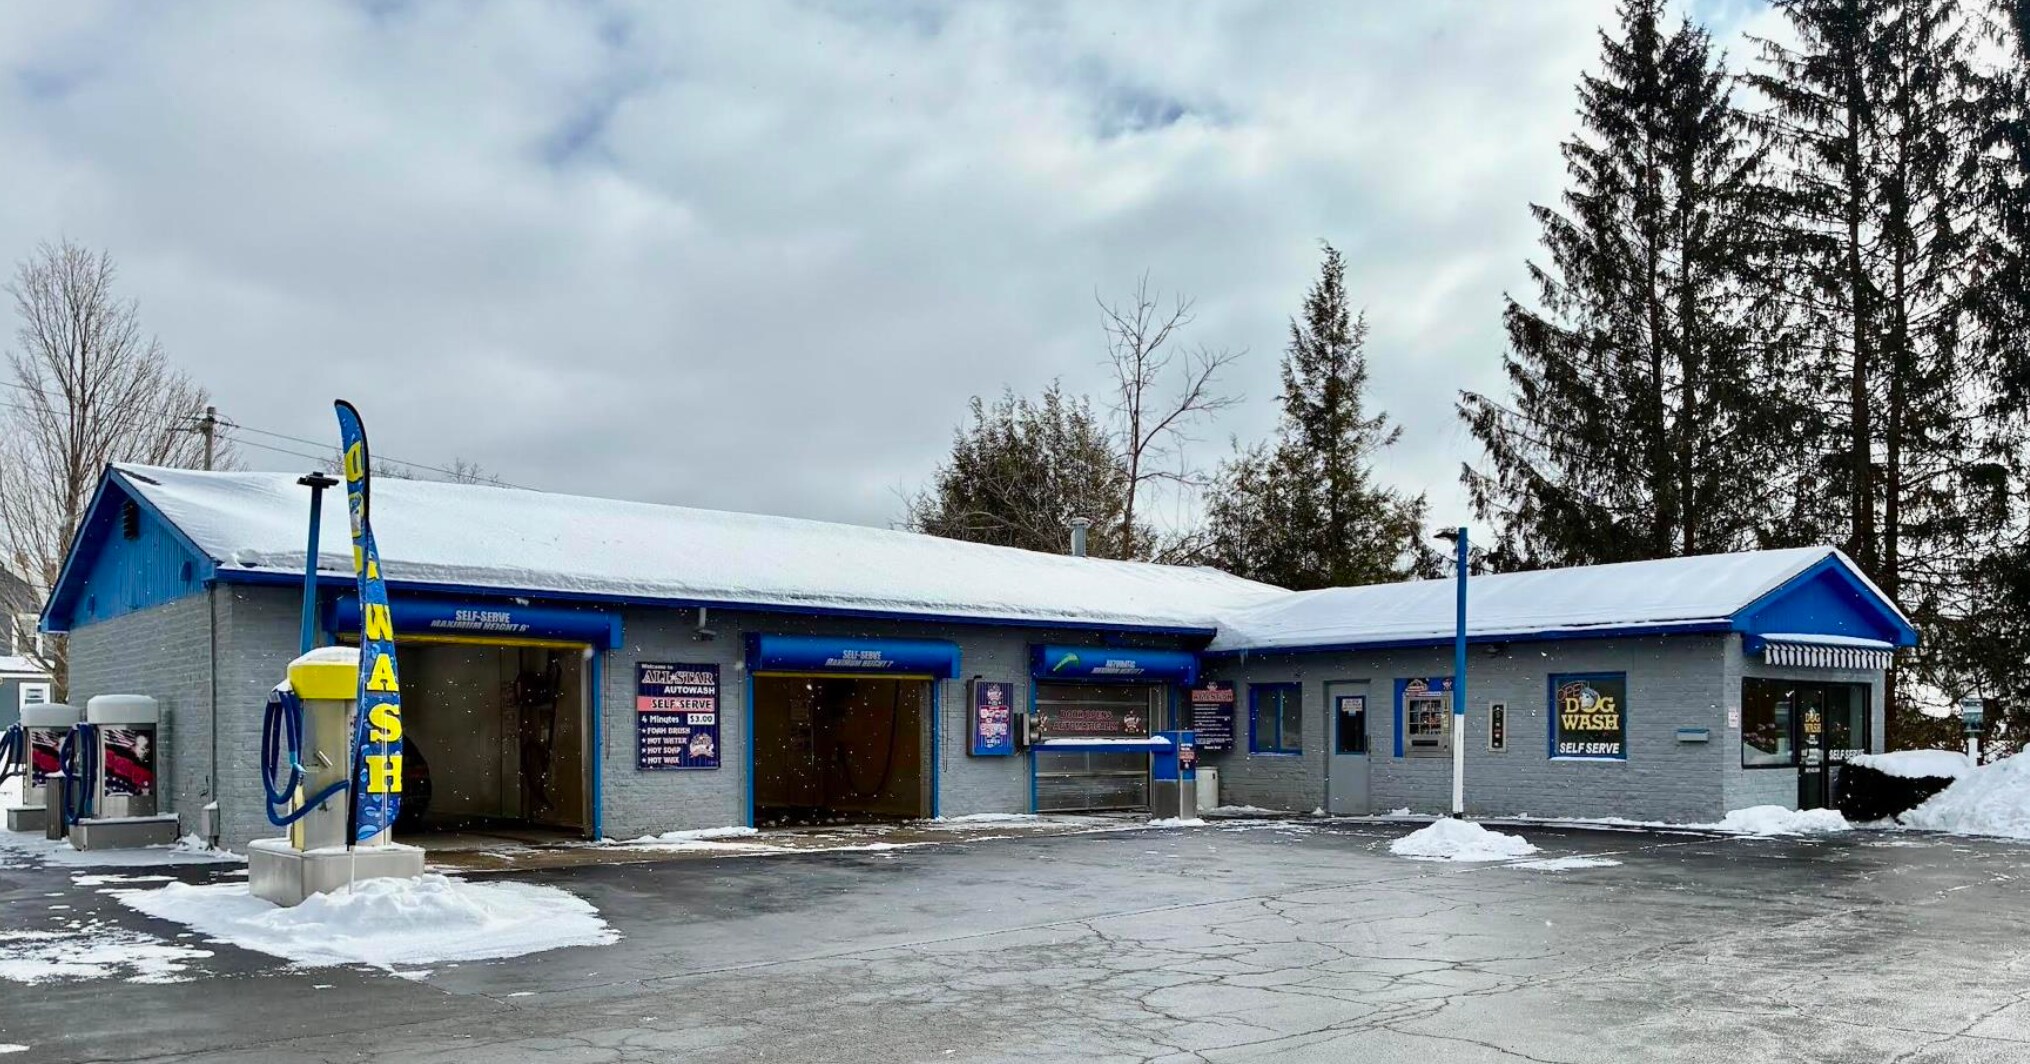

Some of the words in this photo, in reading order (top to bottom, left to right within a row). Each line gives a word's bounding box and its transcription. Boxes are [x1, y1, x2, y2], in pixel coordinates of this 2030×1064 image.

[455, 610, 511, 624] SELF-SERVE
[483, 622, 519, 632] HEIGHT
[664, 686, 715, 694] AUTOWASH
[364, 603, 402, 793] WASH
[1565, 694, 1616, 713] DOG
[641, 715, 648, 723] 4
[649, 715, 679, 725] Minutes
[689, 714, 713, 724] $3.00
[1561, 714, 1619, 731] WASH
[647, 727, 667, 735] FOAM
[647, 737, 662, 745] HOT
[647, 746, 662, 755] HOT
[1560, 742, 1585, 754] SELF
[1586, 742, 1619, 754] SERVE
[1829, 749, 1845, 760] SELF
[647, 756, 662, 765] HOT
